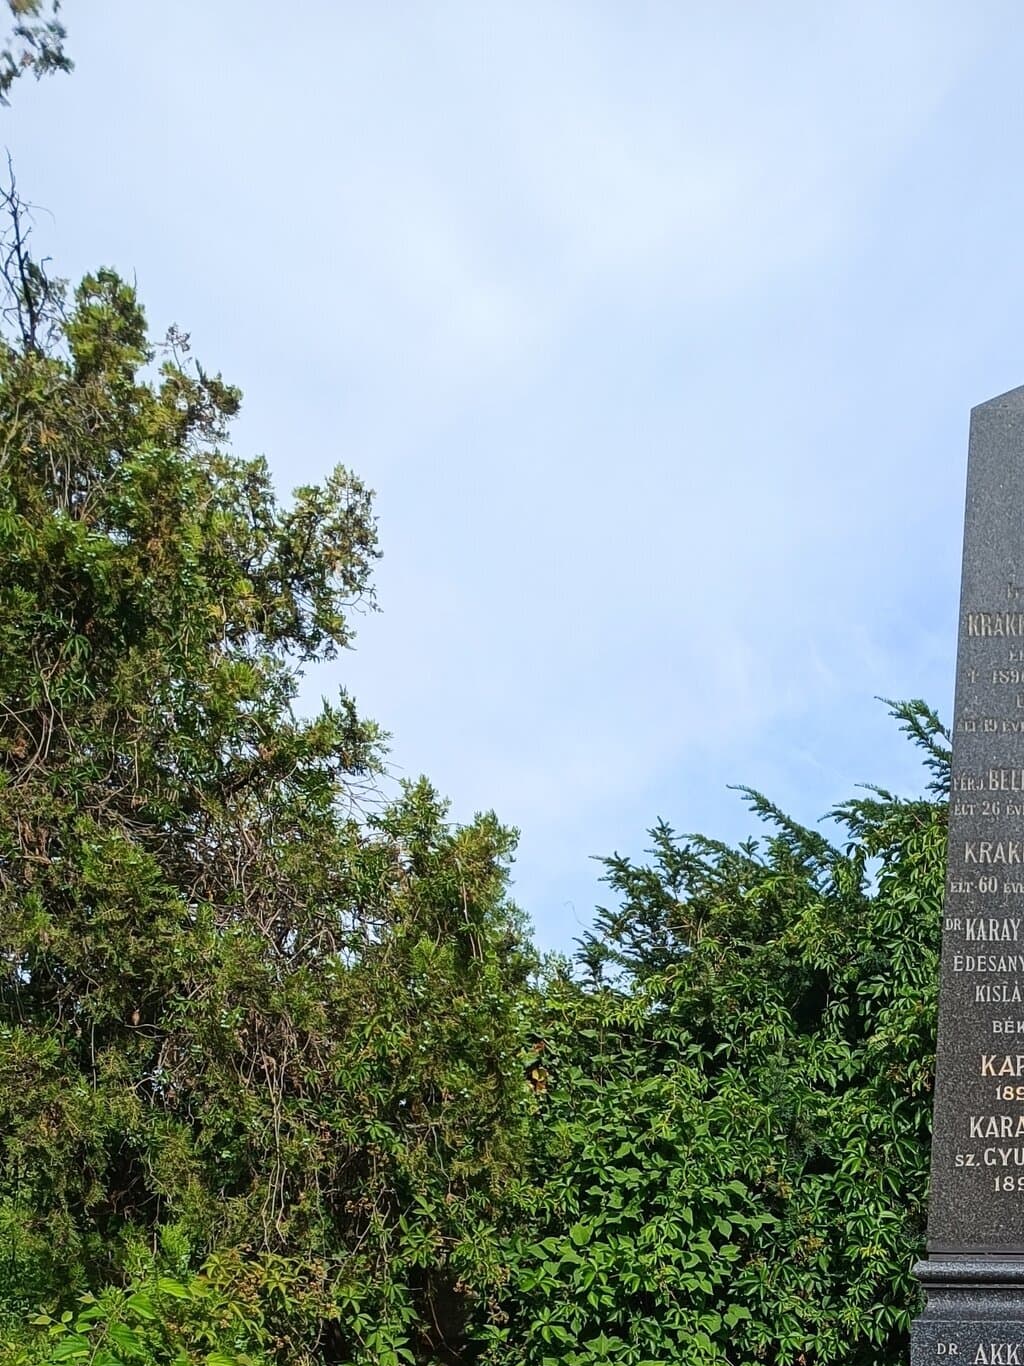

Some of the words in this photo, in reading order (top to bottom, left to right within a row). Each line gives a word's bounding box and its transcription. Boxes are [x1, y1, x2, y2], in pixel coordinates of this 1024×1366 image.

[982, 800, 1001, 816] 26
[979, 875, 998, 894] 60
[965, 918, 1022, 942] KARAY
[937, 1342, 962, 1355] DR.
